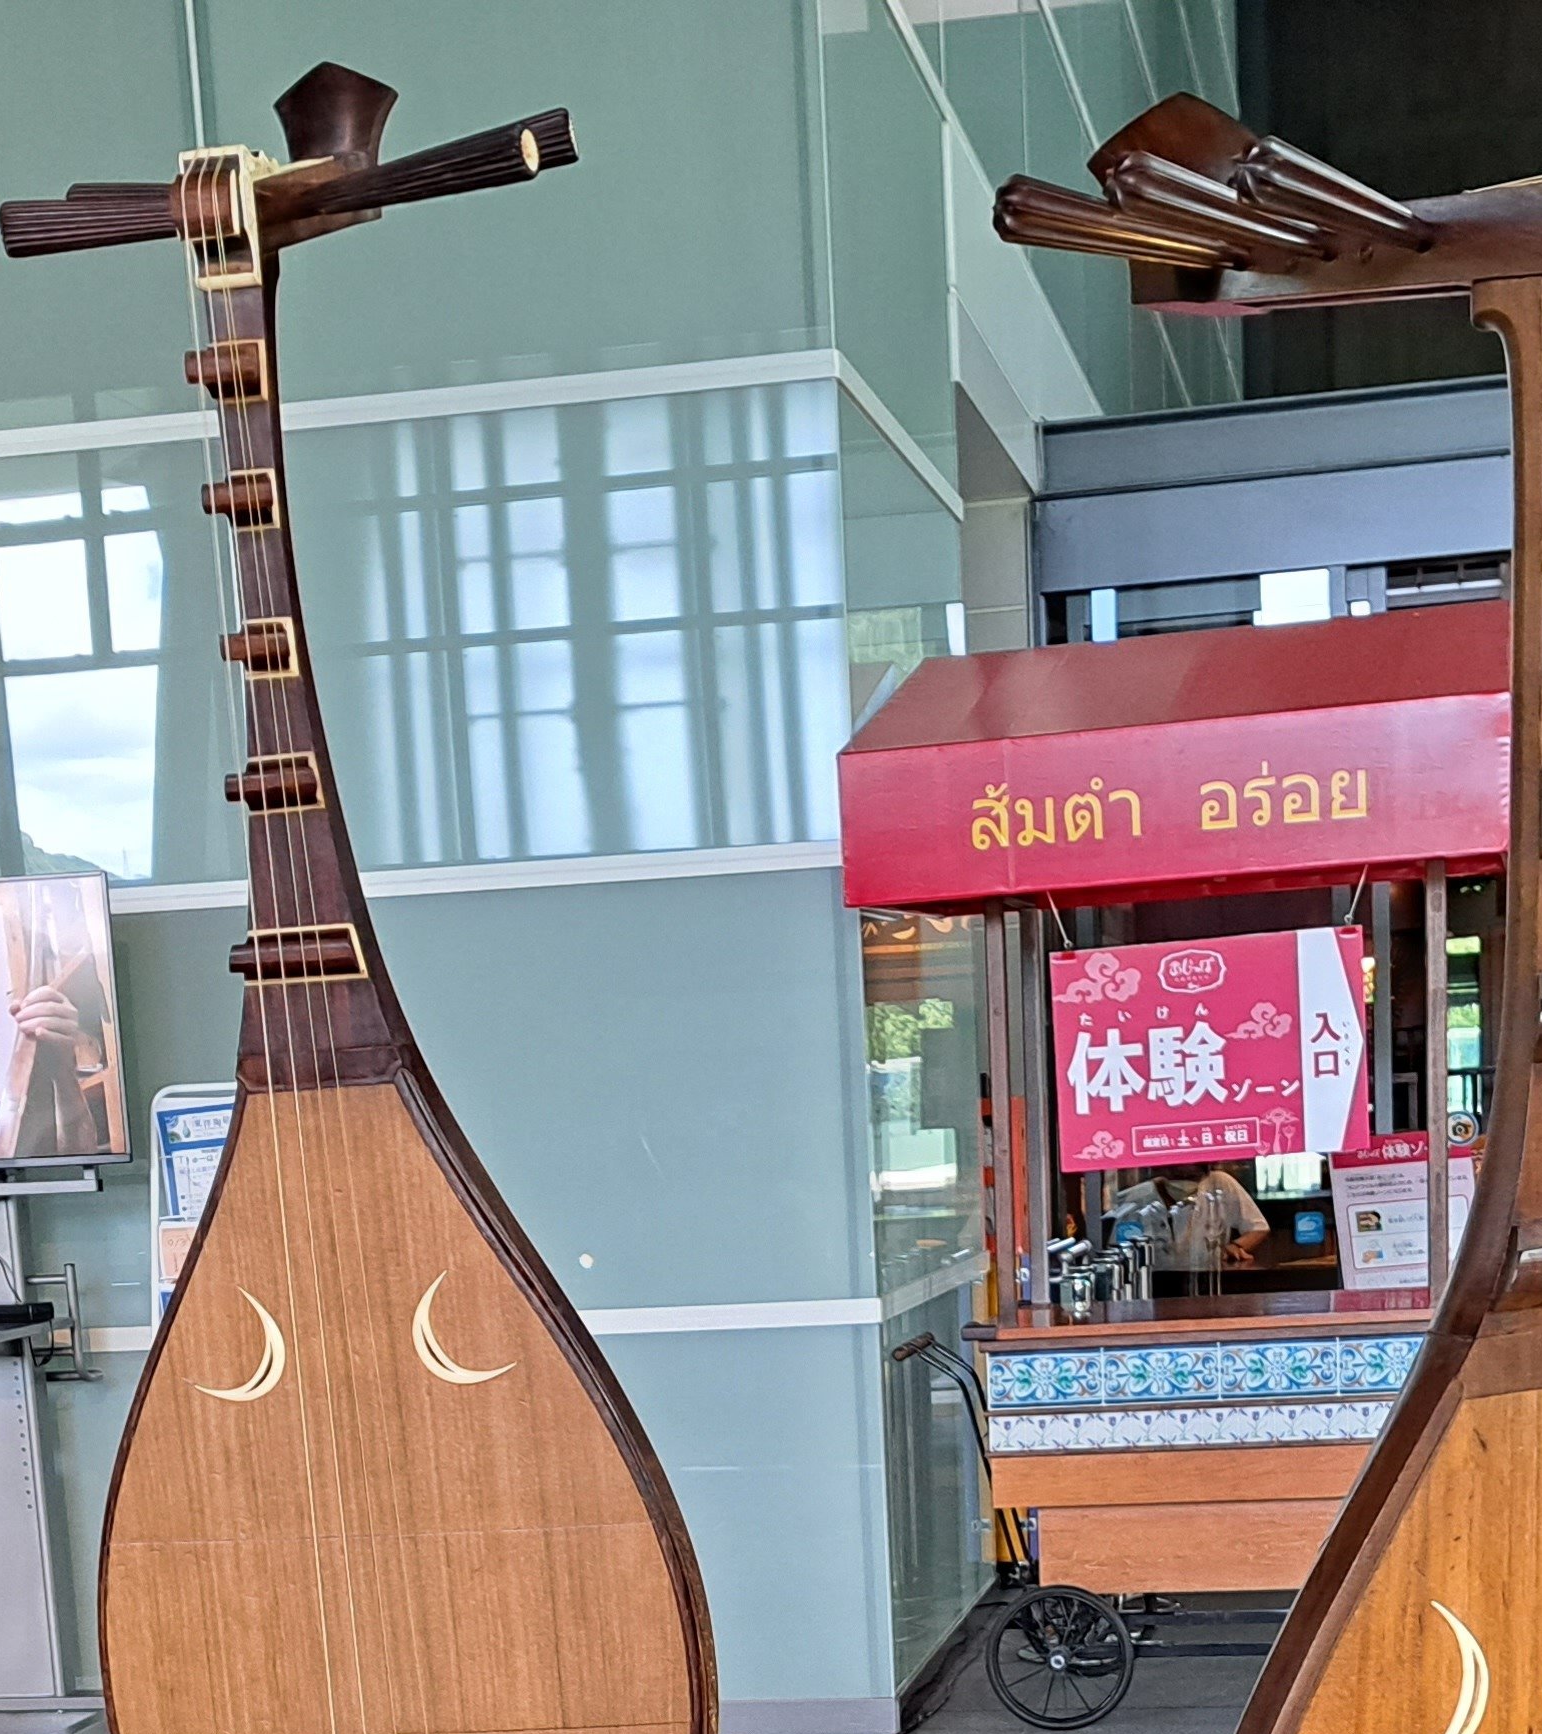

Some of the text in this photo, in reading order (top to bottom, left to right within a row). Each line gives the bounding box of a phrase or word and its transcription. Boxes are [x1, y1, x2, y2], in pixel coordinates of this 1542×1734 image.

[971, 760, 1367, 851] ส้มตำ อร่อย
[1311, 1012, 1340, 1078] 入口
